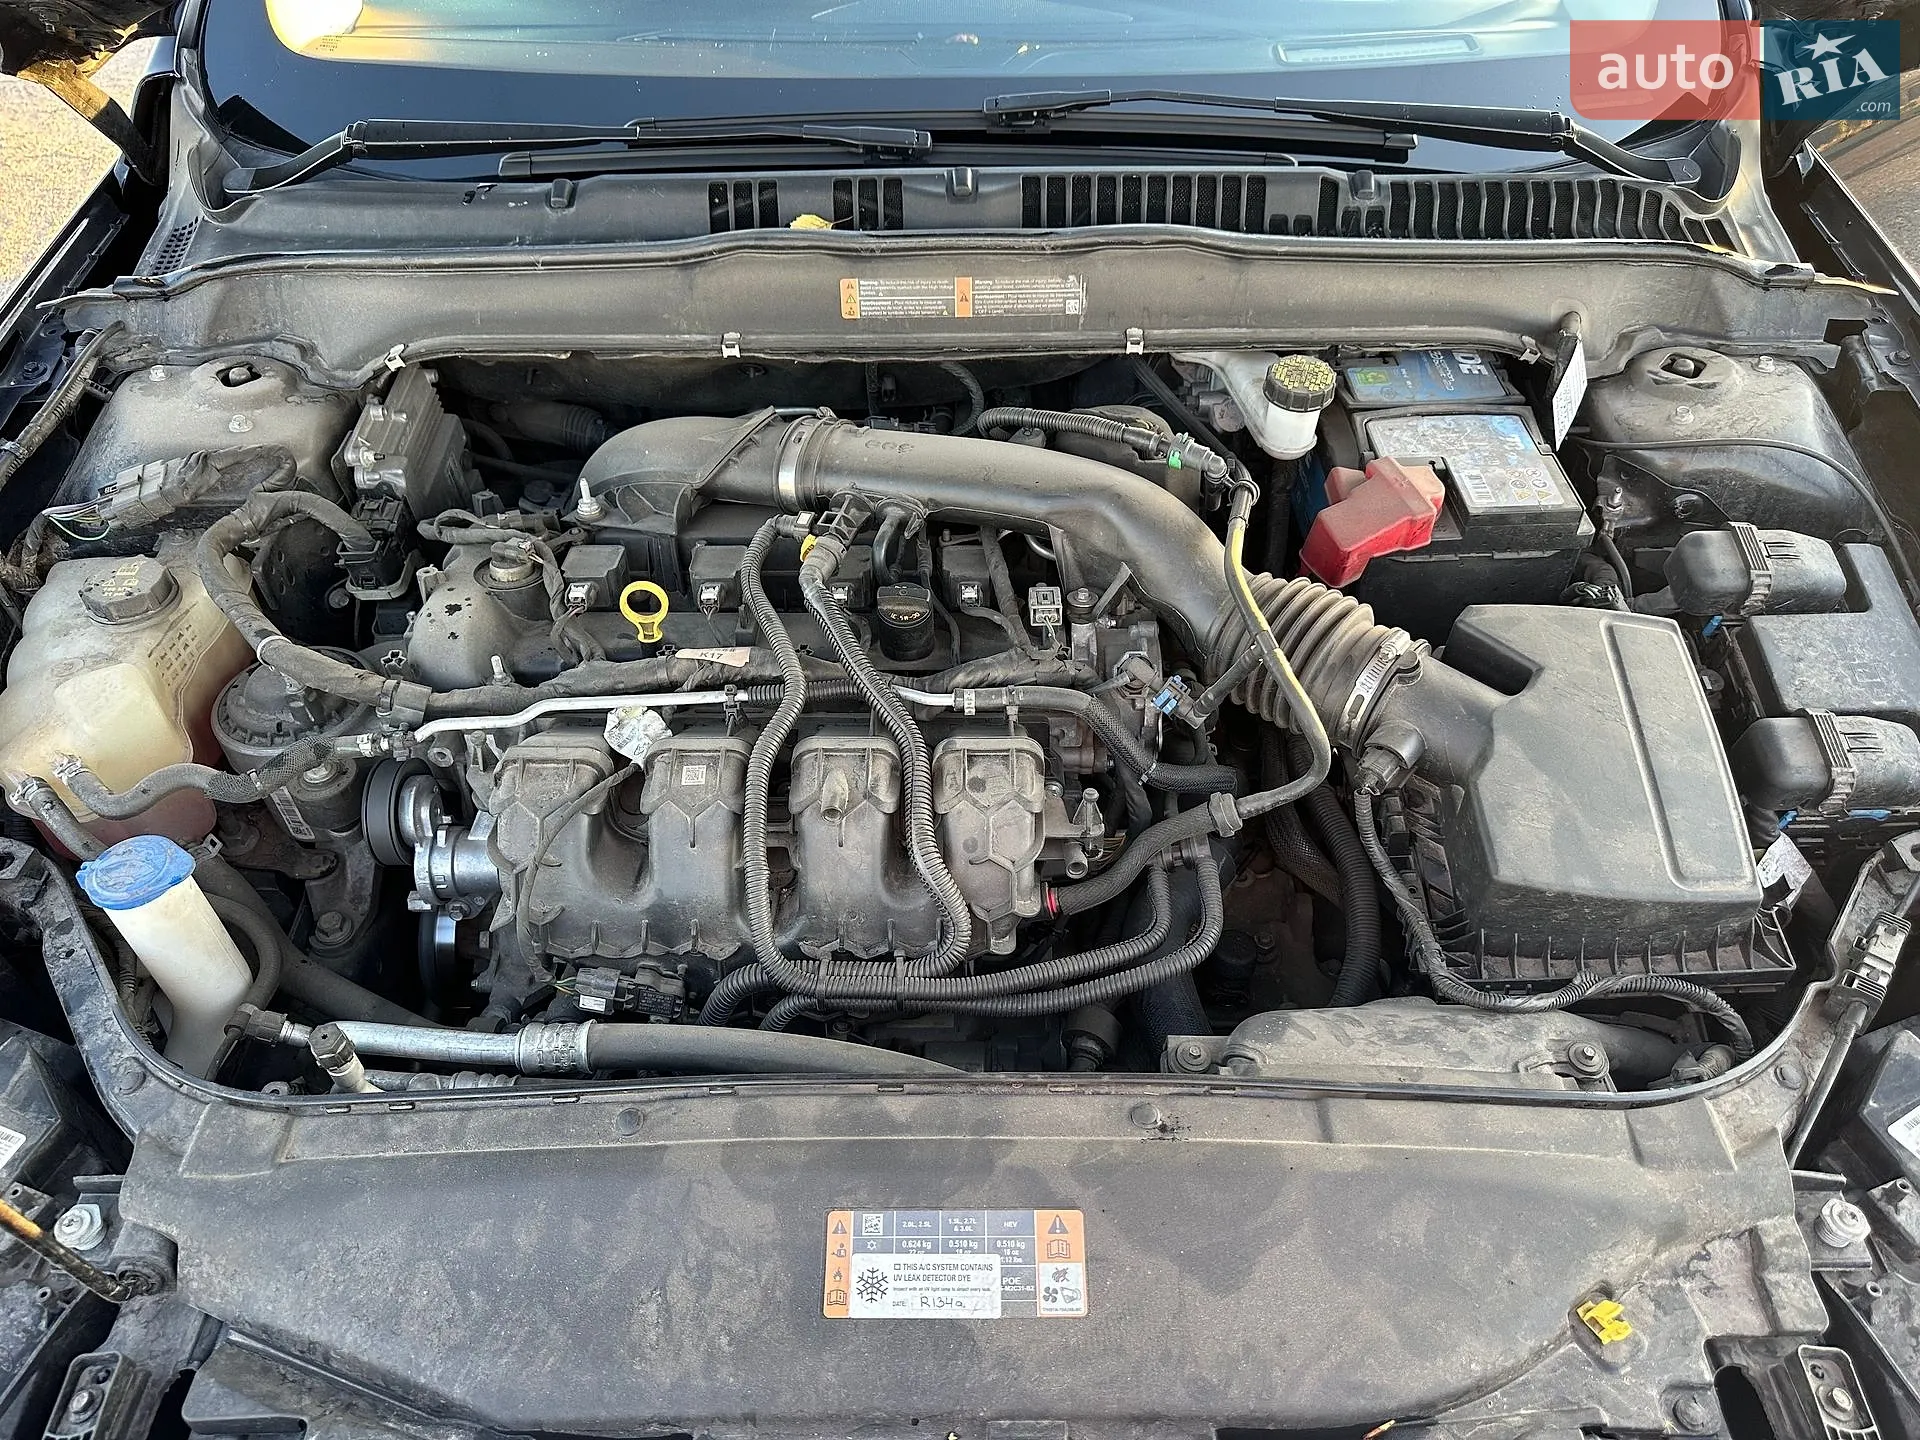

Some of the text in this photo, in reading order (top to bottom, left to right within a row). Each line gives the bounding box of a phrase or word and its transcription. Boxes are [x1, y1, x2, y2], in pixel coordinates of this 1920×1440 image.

[922, 1240, 932, 1249] kg
[969, 1240, 978, 1249] kg
[1017, 1240, 1025, 1249] kg
[960, 1263, 993, 1271] CONTAINS
